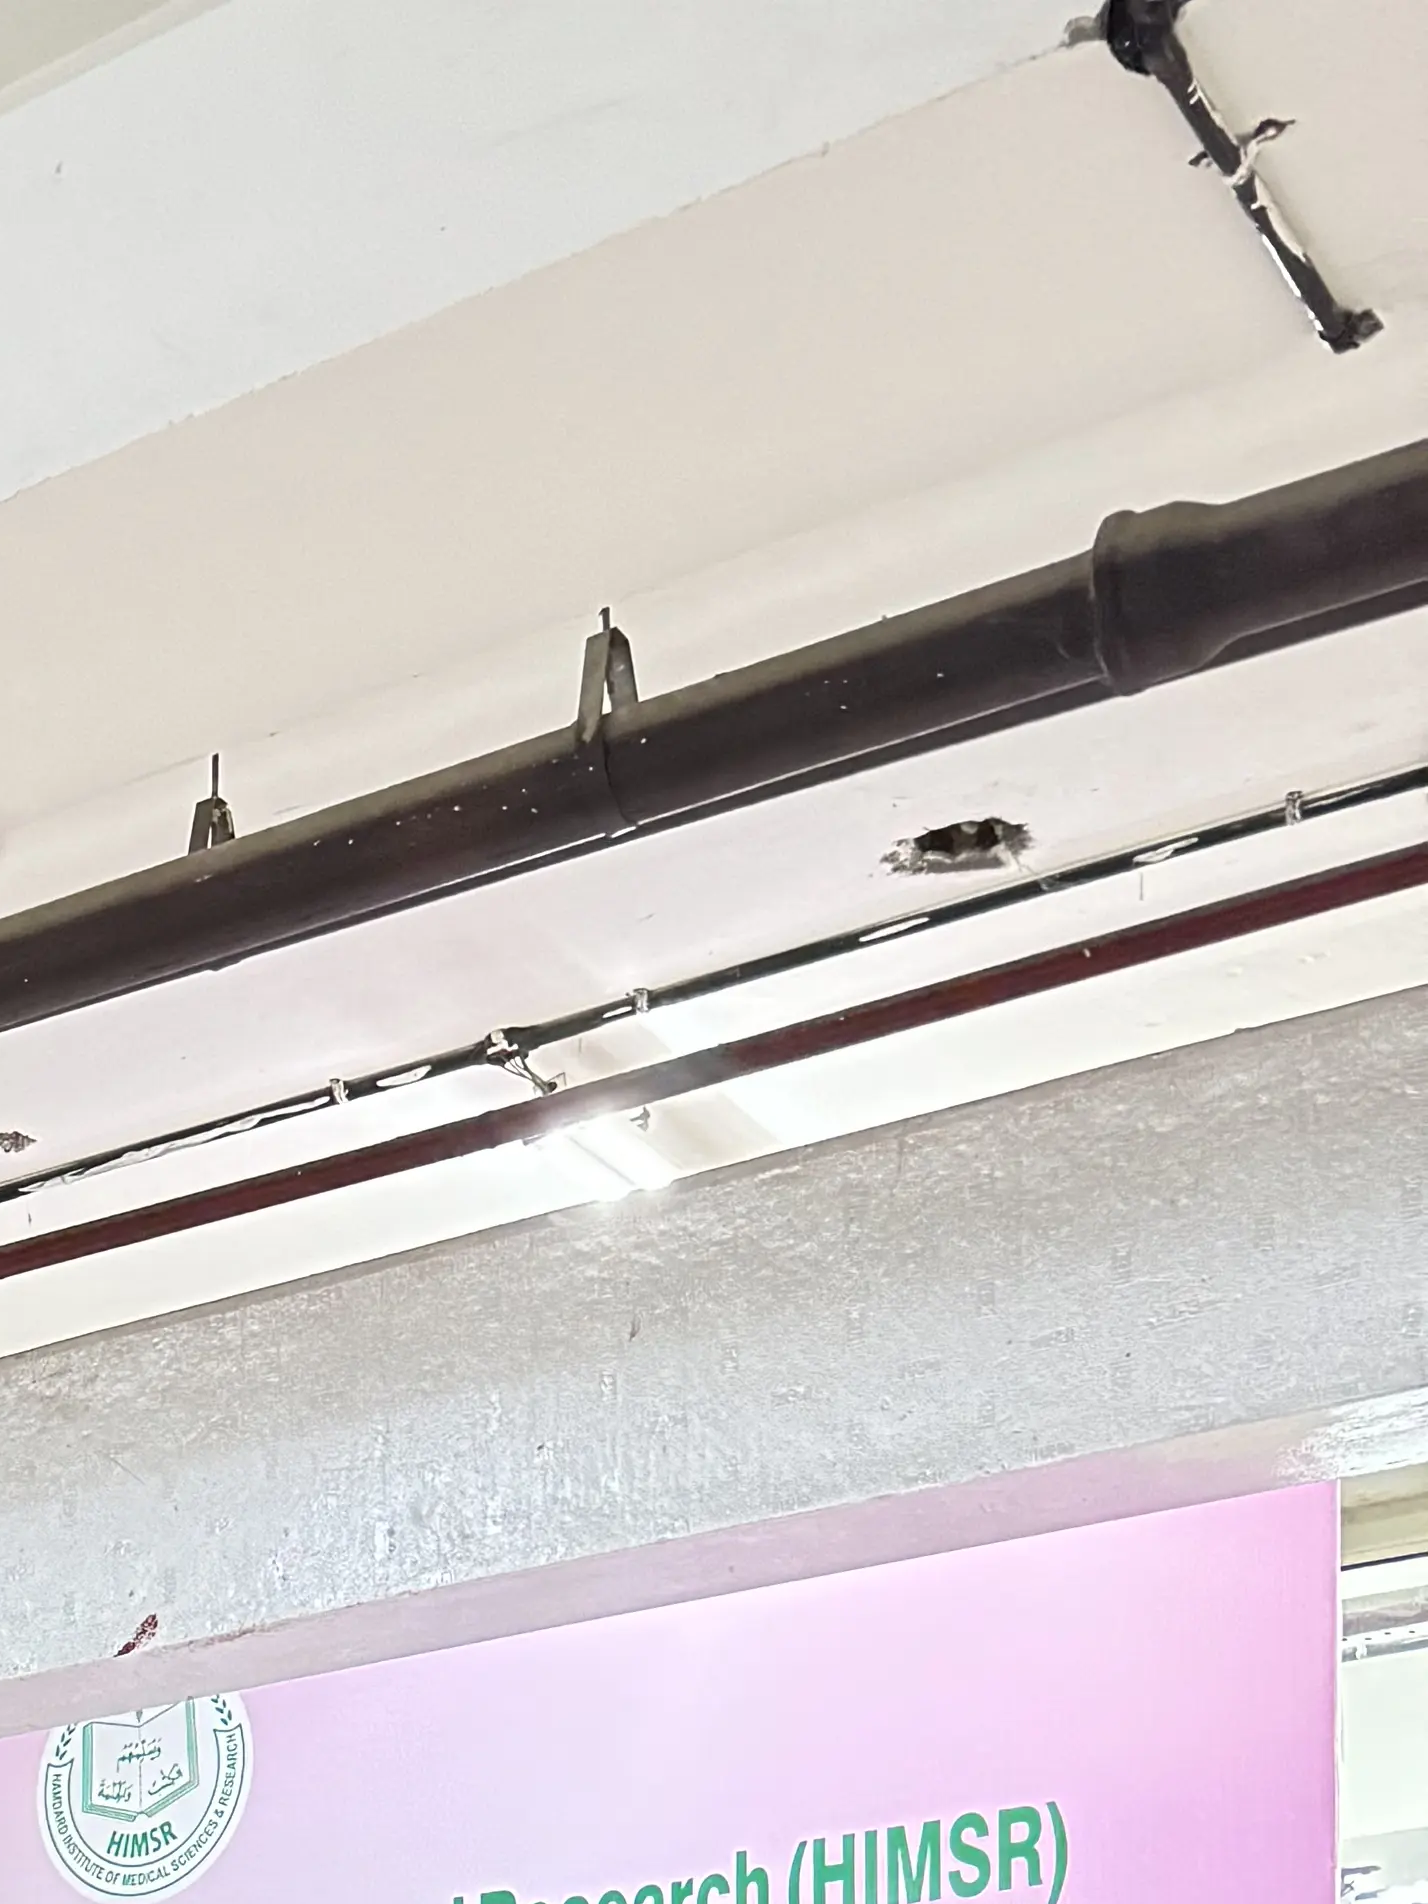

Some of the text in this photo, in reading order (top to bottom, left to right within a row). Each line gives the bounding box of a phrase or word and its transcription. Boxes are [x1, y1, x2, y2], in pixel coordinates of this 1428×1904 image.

[218, 1731, 237, 1806] RESEARCH
[51, 1773, 69, 1837] HAMDARD
[215, 1809, 225, 1819] &
[62, 1834, 104, 1880] INSTITUTE
[107, 1820, 178, 1858] HIMSR
[171, 1819, 220, 1872] SCIENCES
[104, 1869, 121, 1885] OF
[122, 1865, 171, 1886] MEDICAL
